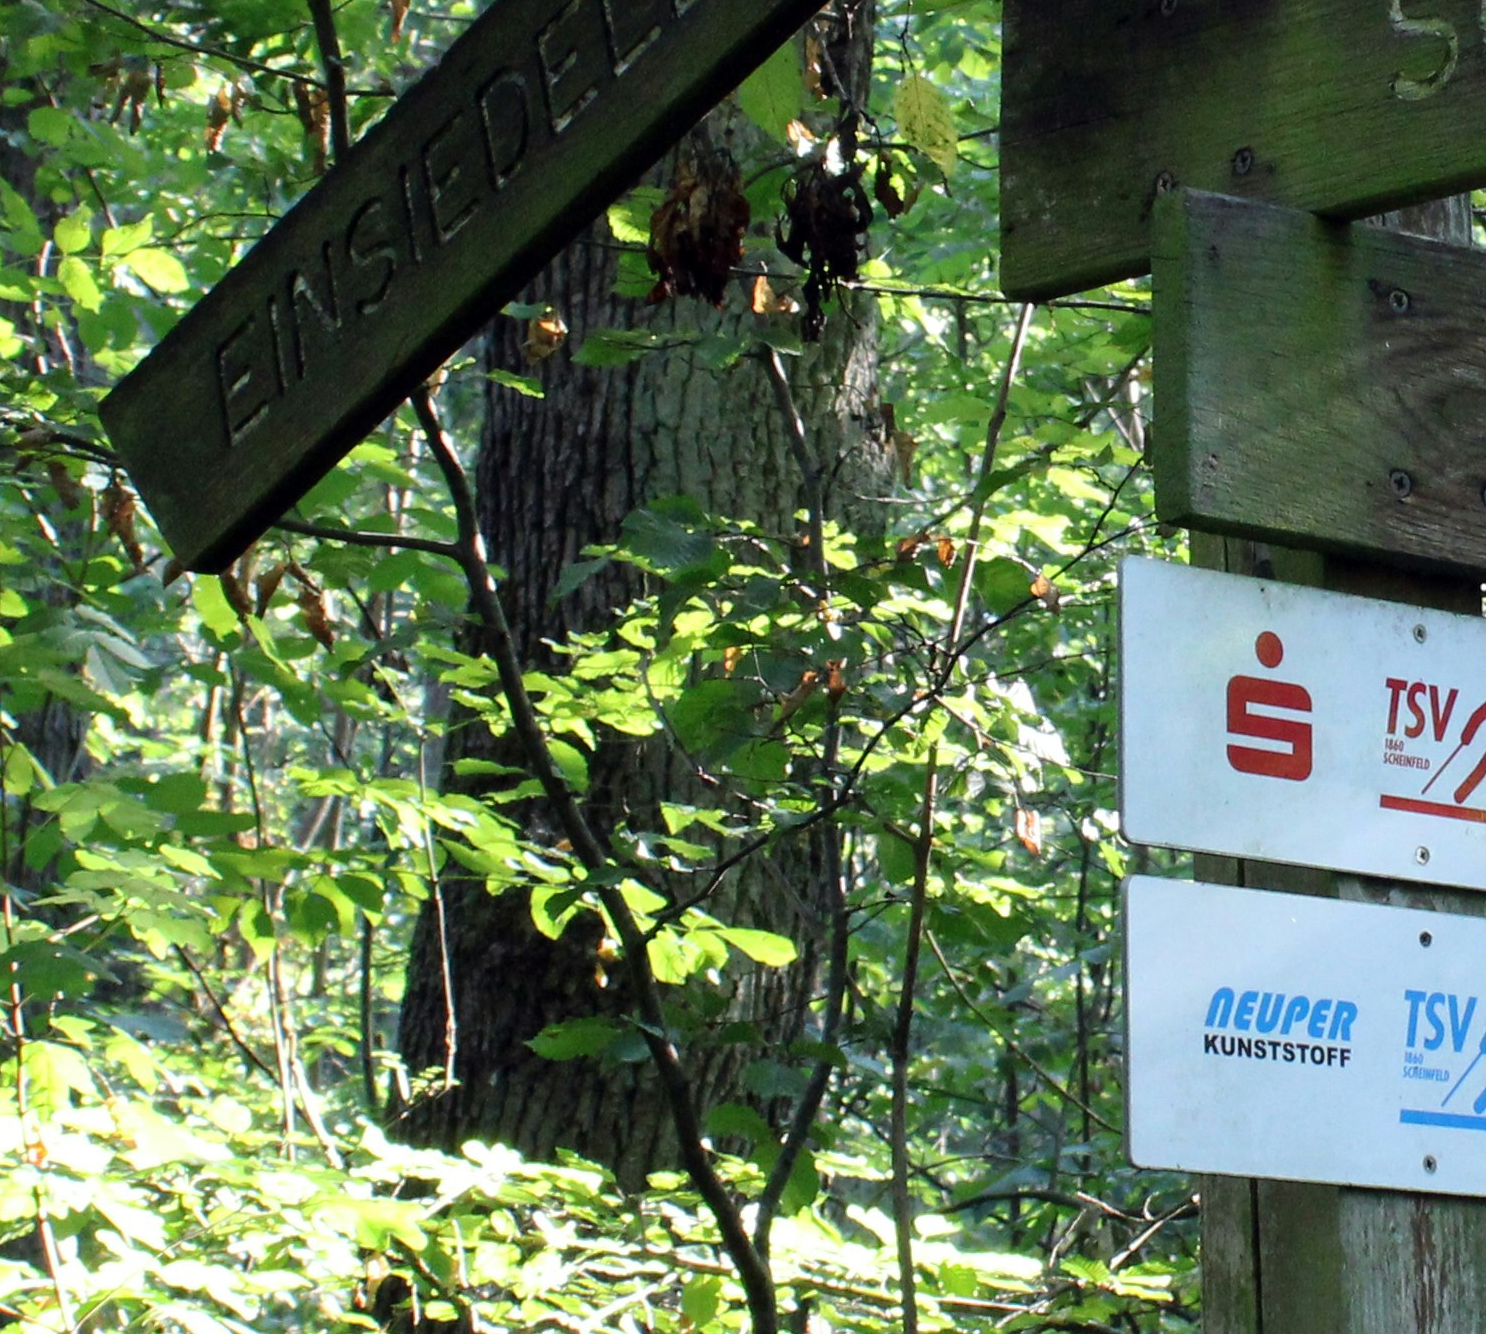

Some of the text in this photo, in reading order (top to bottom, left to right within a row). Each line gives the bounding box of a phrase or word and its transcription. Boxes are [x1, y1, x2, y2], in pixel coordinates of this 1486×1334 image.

[1385, 677, 1459, 742] TSV
[1383, 752, 1431, 770] SCHEINFELD
[1385, 738, 1404, 752] 1860
[1204, 986, 1358, 1041] NEUPER
[1404, 989, 1478, 1053] TSV
[1204, 1034, 1352, 1068] KUNSTSTOFF
